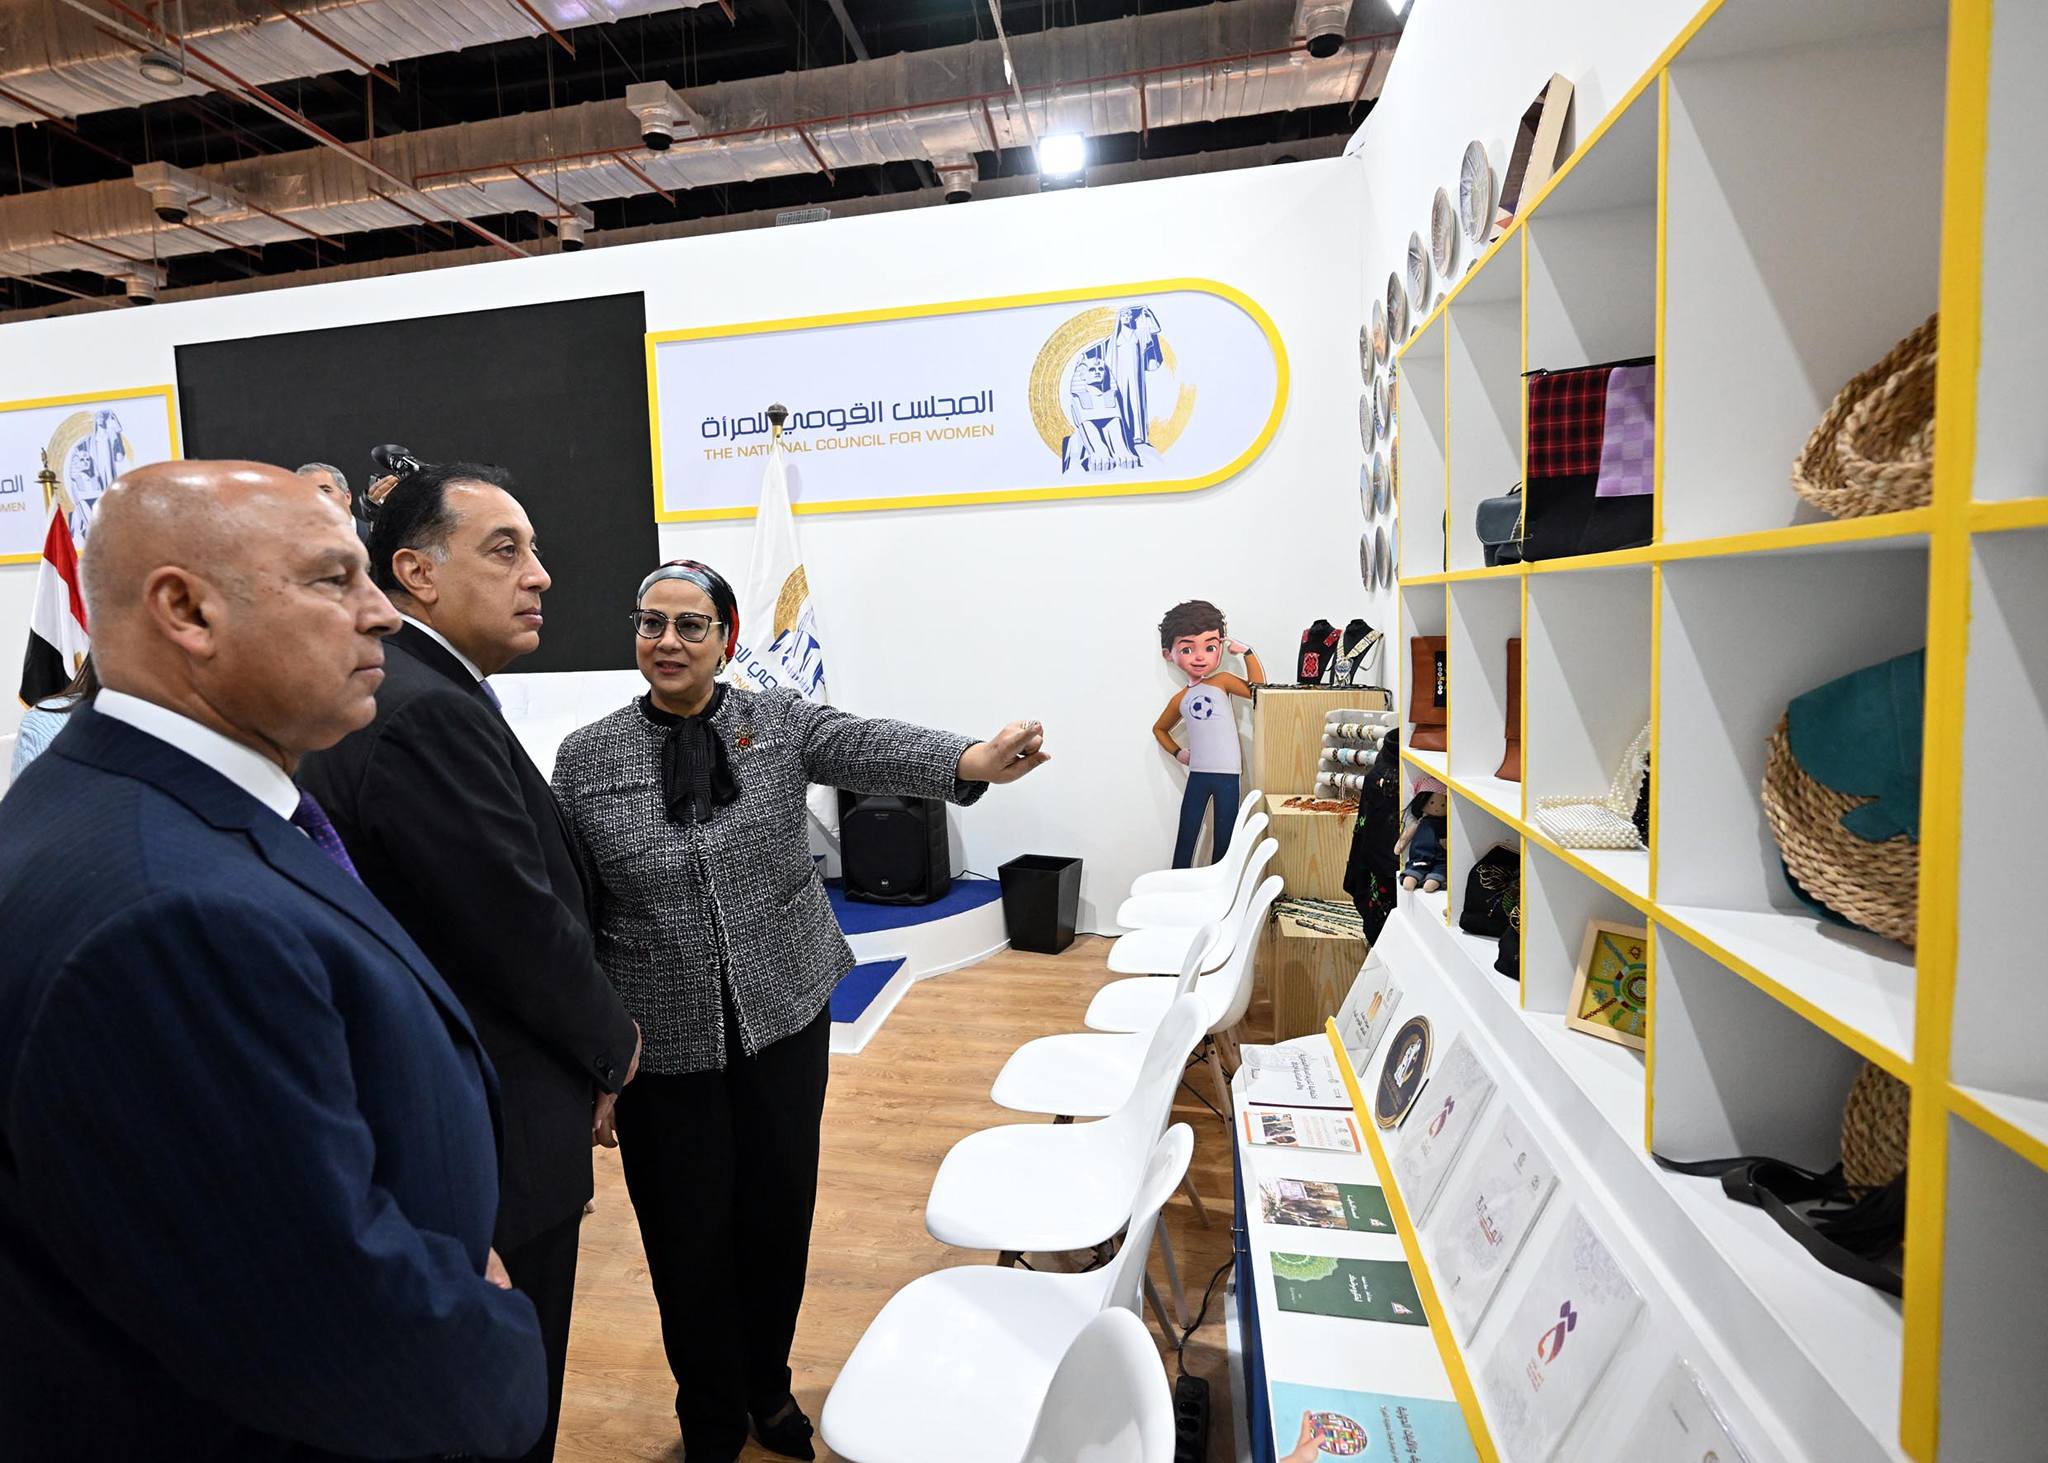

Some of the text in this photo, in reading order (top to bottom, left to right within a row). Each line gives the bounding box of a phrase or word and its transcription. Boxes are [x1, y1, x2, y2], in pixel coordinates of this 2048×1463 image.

[701, 389, 994, 441] المجلس القومي للمرأة
[704, 424, 994, 460] THE NATINAL COUNCIL FOR WOMEN
[0, 502, 26, 513] MEN
